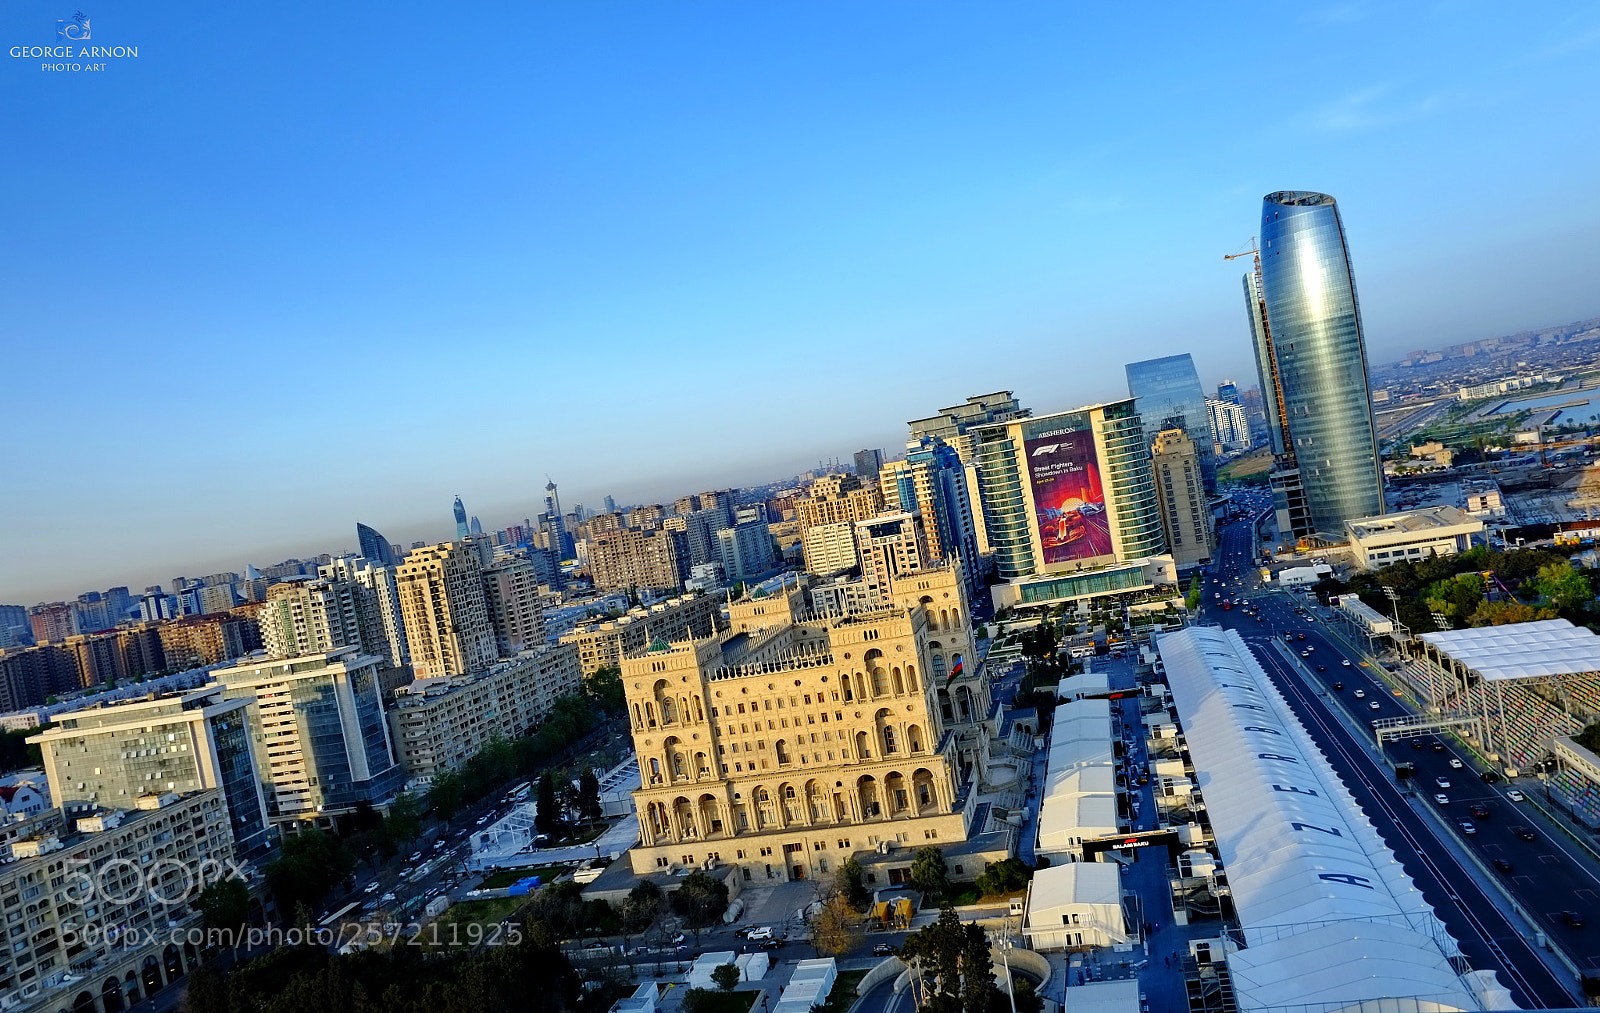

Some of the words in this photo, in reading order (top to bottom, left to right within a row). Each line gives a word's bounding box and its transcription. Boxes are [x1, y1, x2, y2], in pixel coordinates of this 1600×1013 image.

[1038, 426, 1076, 439] ABSHERON
[1034, 465, 1050, 473] Street
[1050, 461, 1073, 471] Fighters
[1034, 470, 1063, 478] Showdown
[1069, 465, 1083, 473] Baku
